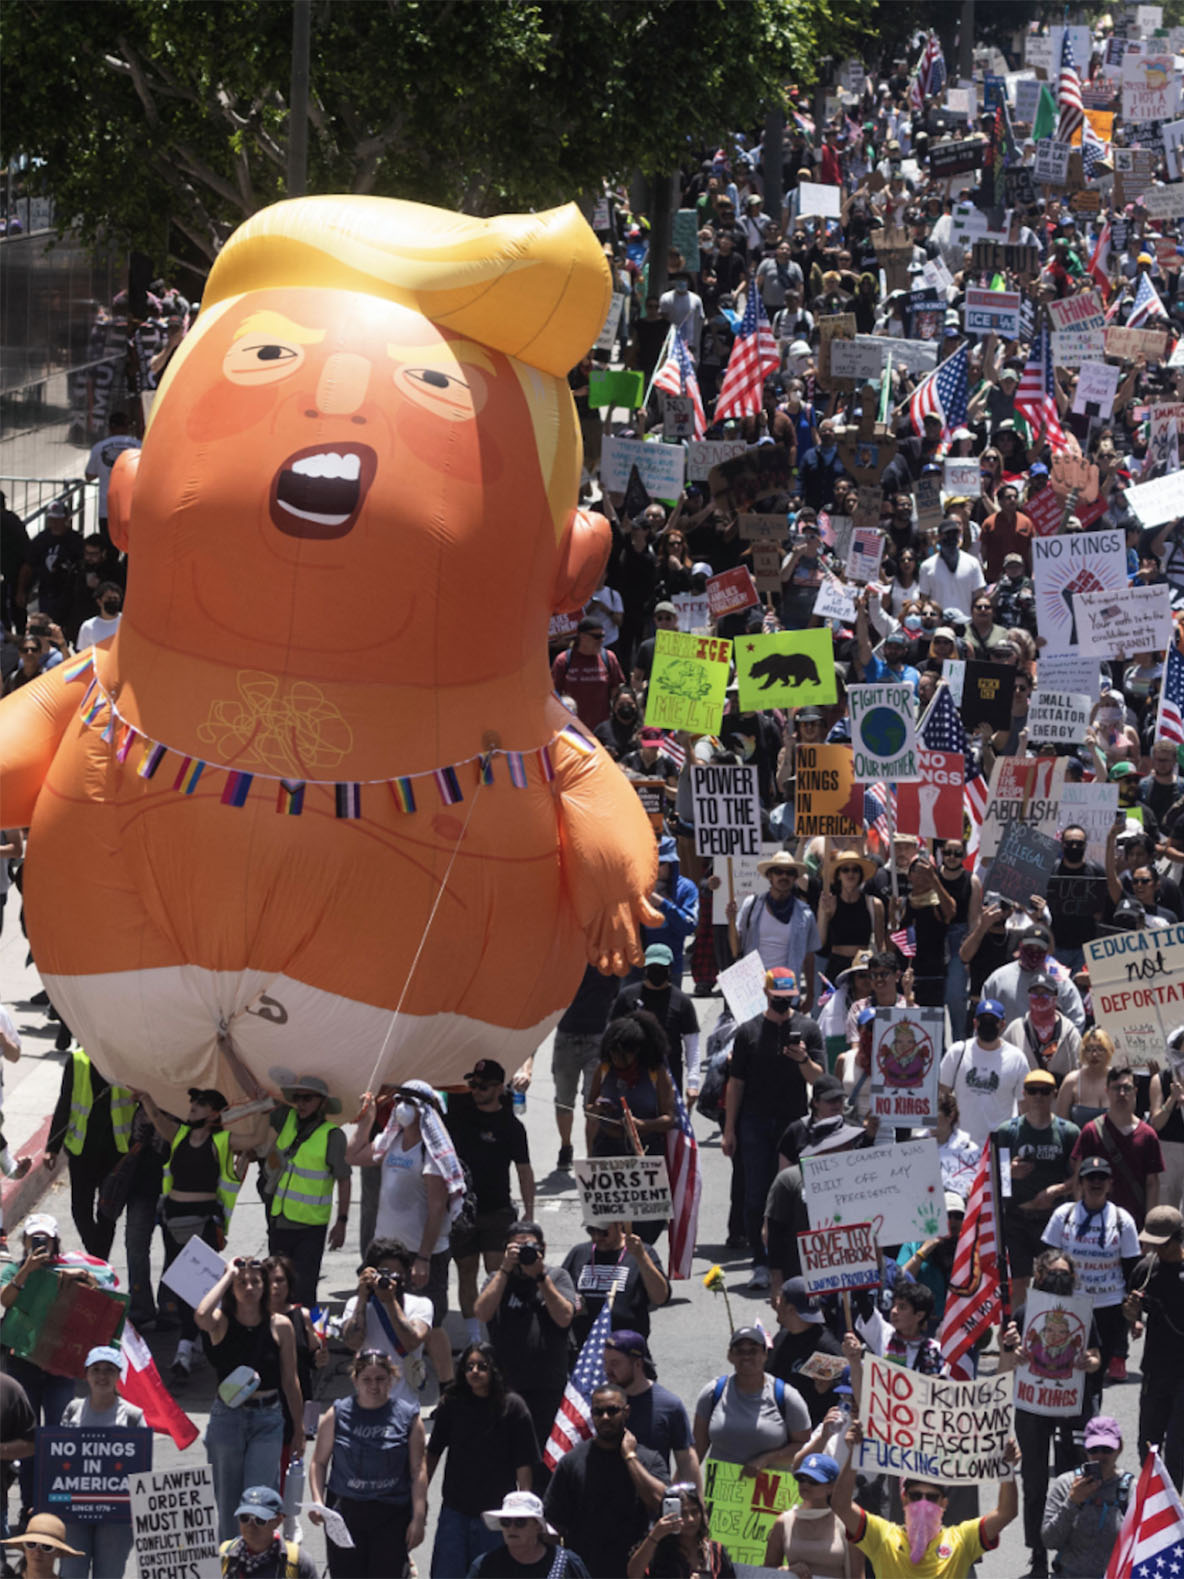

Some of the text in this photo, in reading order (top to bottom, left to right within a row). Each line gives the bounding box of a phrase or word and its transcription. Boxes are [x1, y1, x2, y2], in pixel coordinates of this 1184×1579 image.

[1051, 294, 1100, 326] THINK
[1035, 534, 1121, 559] NO KINGS
[697, 638, 729, 664] ICE
[851, 687, 913, 721] FIGHT FOR
[981, 687, 996, 699] ICE
[1038, 693, 1074, 709] SMALL
[652, 694, 723, 731] MELT
[1032, 722, 1076, 739] ENERGY
[797, 747, 818, 770] NO
[853, 752, 918, 779] OUR MOTHER
[917, 752, 947, 769] NO
[695, 766, 754, 796] POWER
[797, 769, 839, 792] KINGS
[697, 796, 755, 825] TO THE
[796, 792, 812, 813] IN
[985, 800, 1059, 821] ABOLISH
[796, 814, 858, 837] AMERICA
[698, 827, 760, 856] PEOPLE
[1125, 952, 1174, 983] not
[876, 1095, 931, 1116] NO KINGS
[586, 1160, 638, 1172] TRUMP
[807, 1159, 840, 1177] THIS
[578, 1171, 659, 1191] WORST
[811, 1173, 878, 1194] BUILT OFF
[583, 1188, 668, 1203] PRESIDENT
[592, 1203, 626, 1216] SINCE
[801, 1227, 872, 1255] LOVE THY
[806, 1245, 877, 1270] NEIGHBOR
[872, 1363, 1008, 1408] NO KINGS
[1018, 1381, 1078, 1407] NO KINGS
[869, 1394, 1011, 1437] NO CROWNS
[50, 1441, 136, 1457] NO KINGS
[866, 1416, 1009, 1460] NO FASCIST
[83, 1459, 102, 1474] IN
[859, 1437, 1011, 1479] FUCKING CLOWNS
[52, 1475, 129, 1492] AMERICA
[135, 1469, 211, 1495] A LAWFUL
[71, 1503, 111, 1513] SINCE 1776
[148, 1490, 202, 1511] ORDER
[135, 1505, 215, 1534] MUST NOT
[135, 1528, 216, 1553] CONFLICT WITH
[139, 1545, 220, 1567] CONSTITUTIONAL
[140, 1562, 201, 1579] RIGHTS
